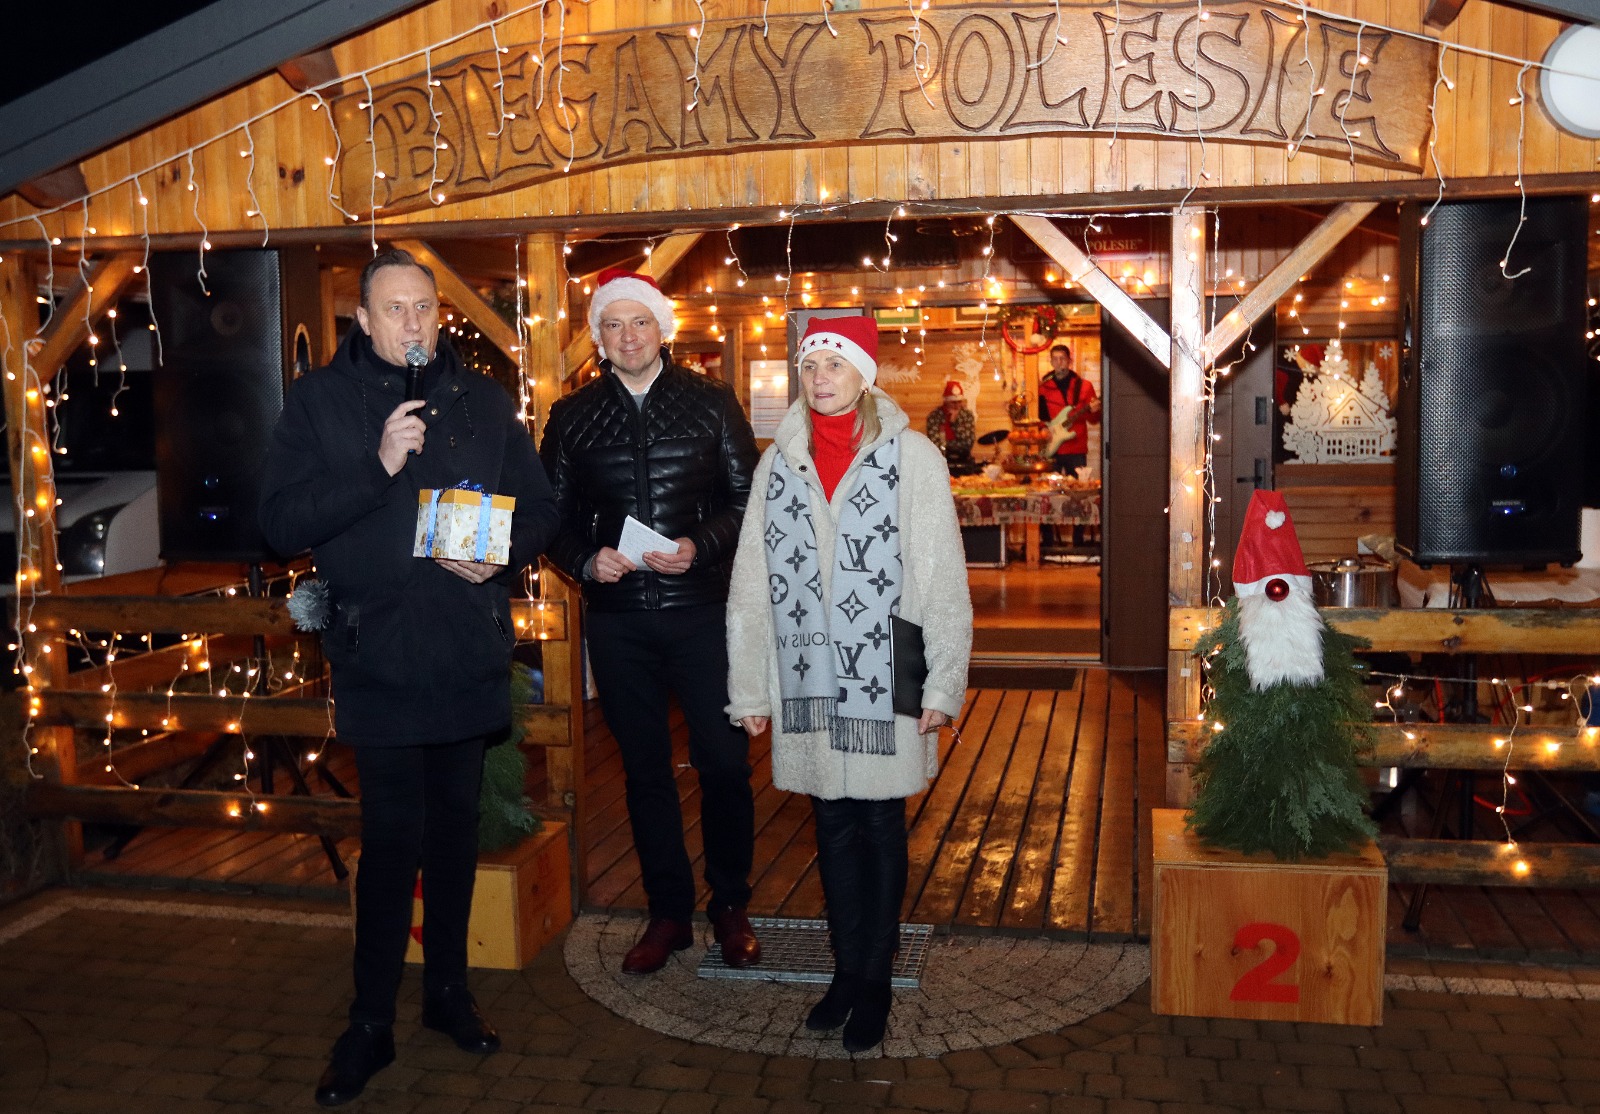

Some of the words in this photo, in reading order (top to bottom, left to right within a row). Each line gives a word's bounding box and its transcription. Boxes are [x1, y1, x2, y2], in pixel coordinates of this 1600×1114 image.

[373, 22, 828, 208] BIEGAMY
[859, 9, 1401, 161] POLESIE
[1230, 922, 1301, 1004] 2
